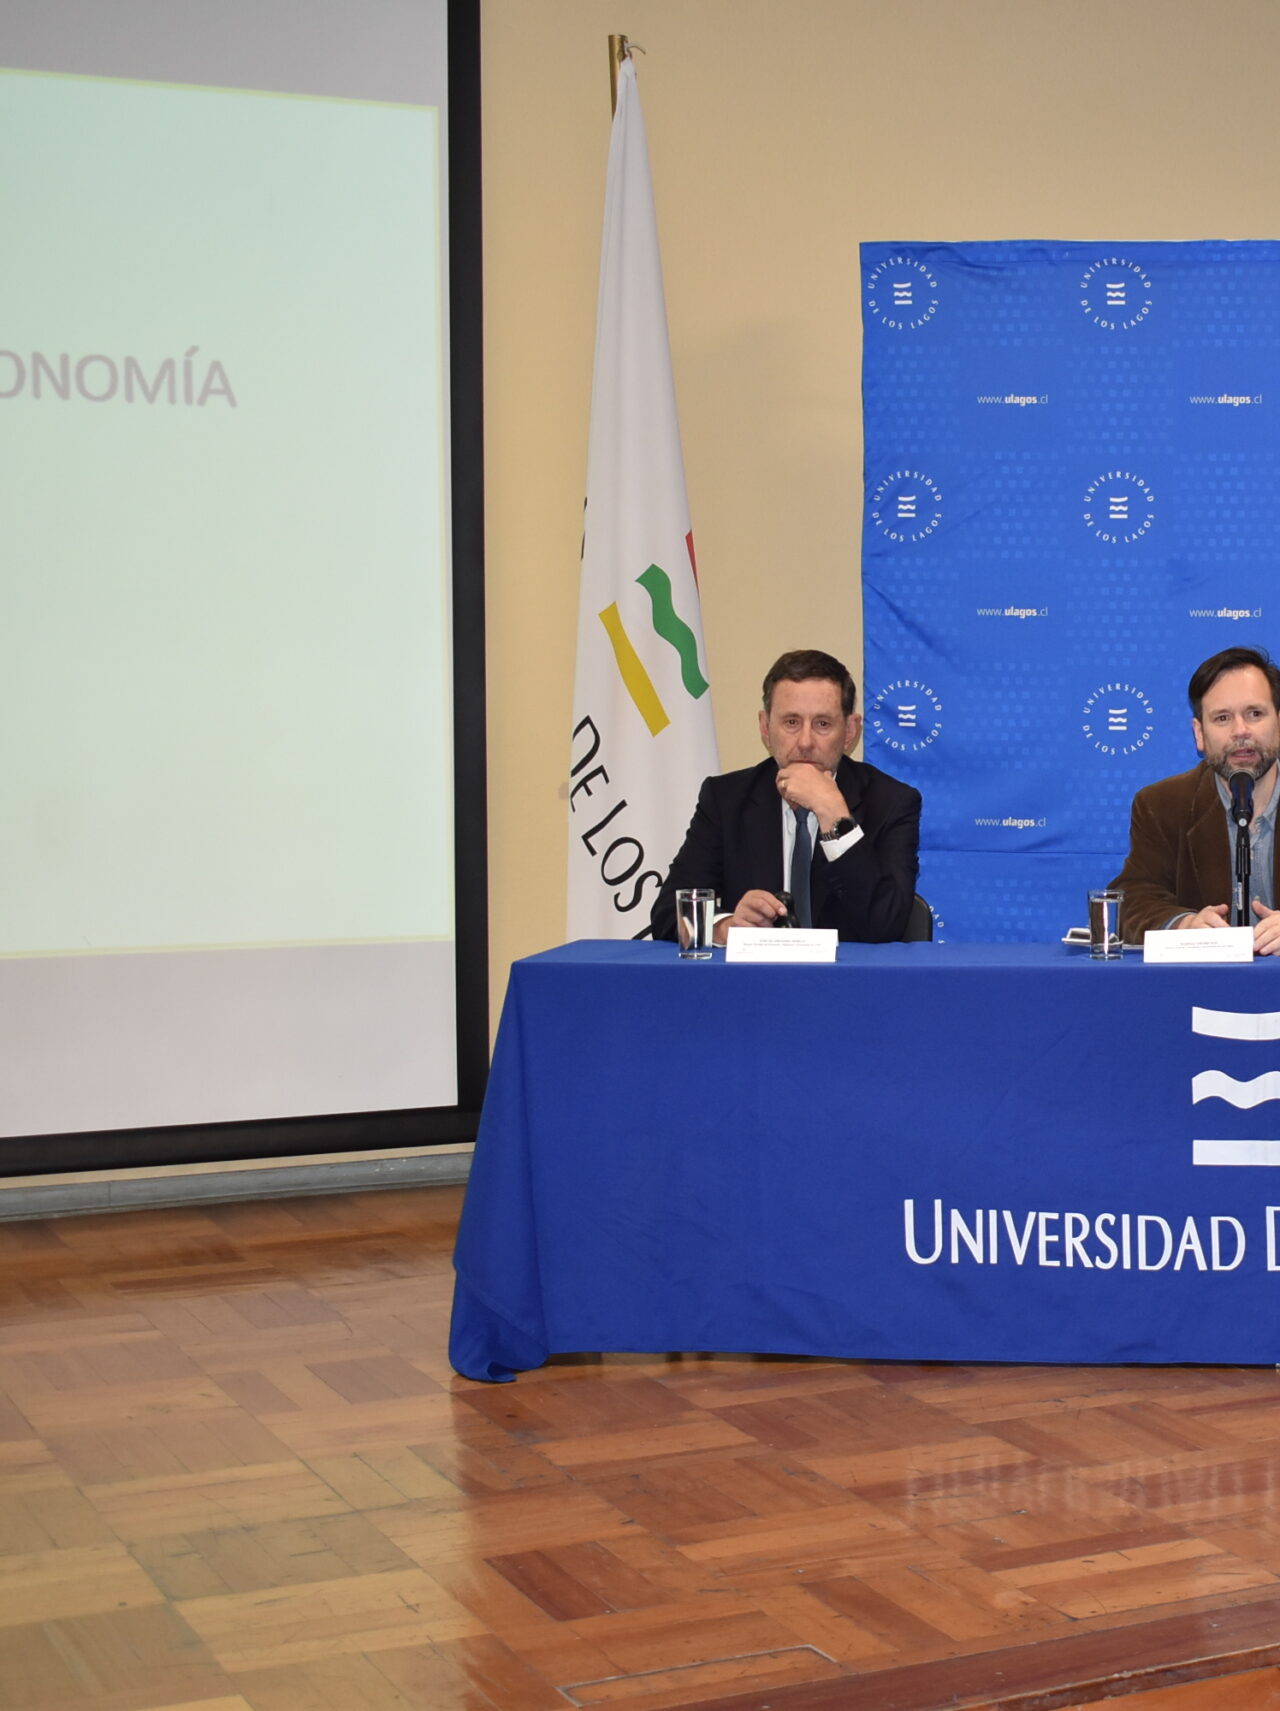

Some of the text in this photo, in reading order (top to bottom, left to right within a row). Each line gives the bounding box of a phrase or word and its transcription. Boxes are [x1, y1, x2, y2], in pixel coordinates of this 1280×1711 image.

[867, 256, 938, 290] UNIVERSIDAD
[1079, 256, 1152, 289] UNIVERSIDAD
[867, 299, 940, 331] DE LOS LAGOS
[1079, 298, 1153, 331] DE LOS LAGOS
[976, 393, 1049, 408] www.ulagos.cl
[1189, 392, 1263, 408] www.ulagos.cl
[873, 469, 943, 502] UNIVERSIDAD
[1083, 470, 1155, 503] UNIVERSIDAD
[871, 511, 943, 543] DE LOS LAGOS
[1082, 512, 1155, 545] DE LOS LAGOS
[976, 605, 1049, 620] www.ulagos.cl
[1188, 606, 1262, 621] www.ulagos.cl
[873, 679, 943, 712] UNIVERSIDAD
[1082, 682, 1154, 715] UNIVERSIDAD
[872, 719, 943, 752] DE LOS LAGOS
[1081, 724, 1154, 756] DE LOS LAGOS
[974, 816, 1047, 830] www.ulagos.cl
[581, 799, 663, 912] LOS
[904, 1198, 1246, 1271] UNIVERSIDAD
